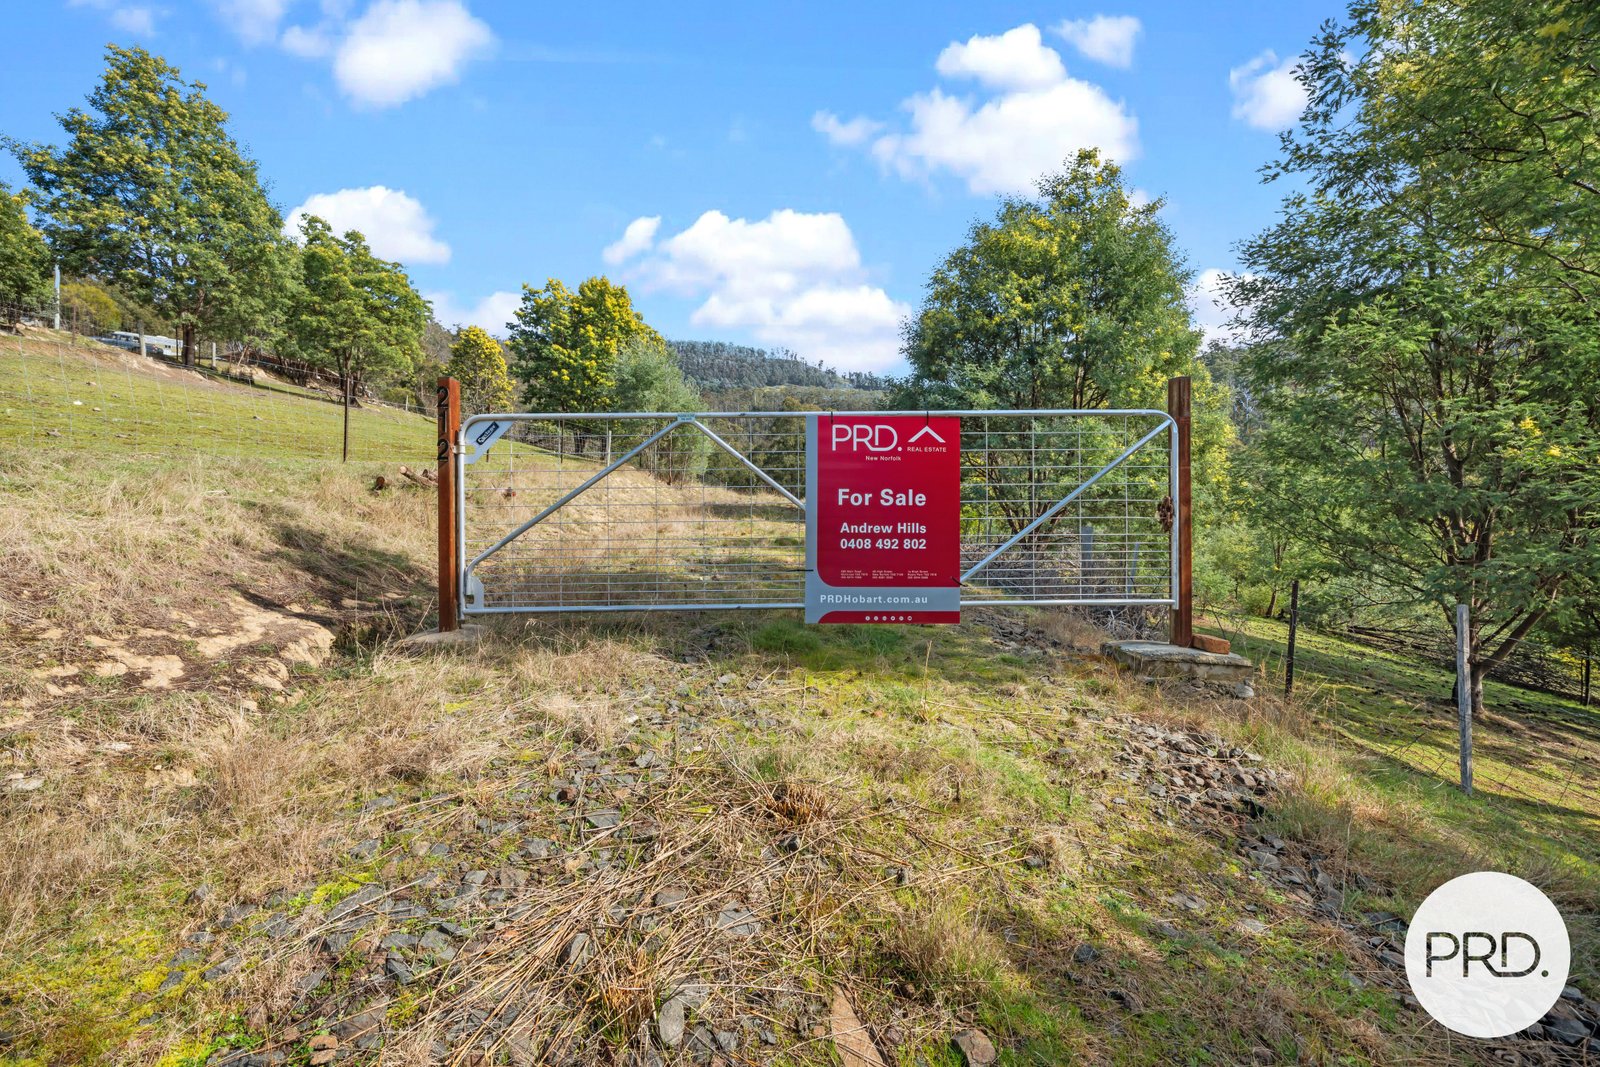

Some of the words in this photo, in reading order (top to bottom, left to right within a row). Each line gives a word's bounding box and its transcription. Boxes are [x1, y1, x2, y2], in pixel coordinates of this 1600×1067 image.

[832, 424, 902, 451] PRD.
[838, 488, 873, 506] For
[880, 488, 927, 506] Sale
[840, 522, 893, 534] Andrew
[897, 522, 927, 534] Hills
[840, 538, 872, 550] 0408
[875, 538, 899, 550] 492
[903, 538, 927, 550] 802
[820, 594, 928, 604] PRDHobart.com.au
